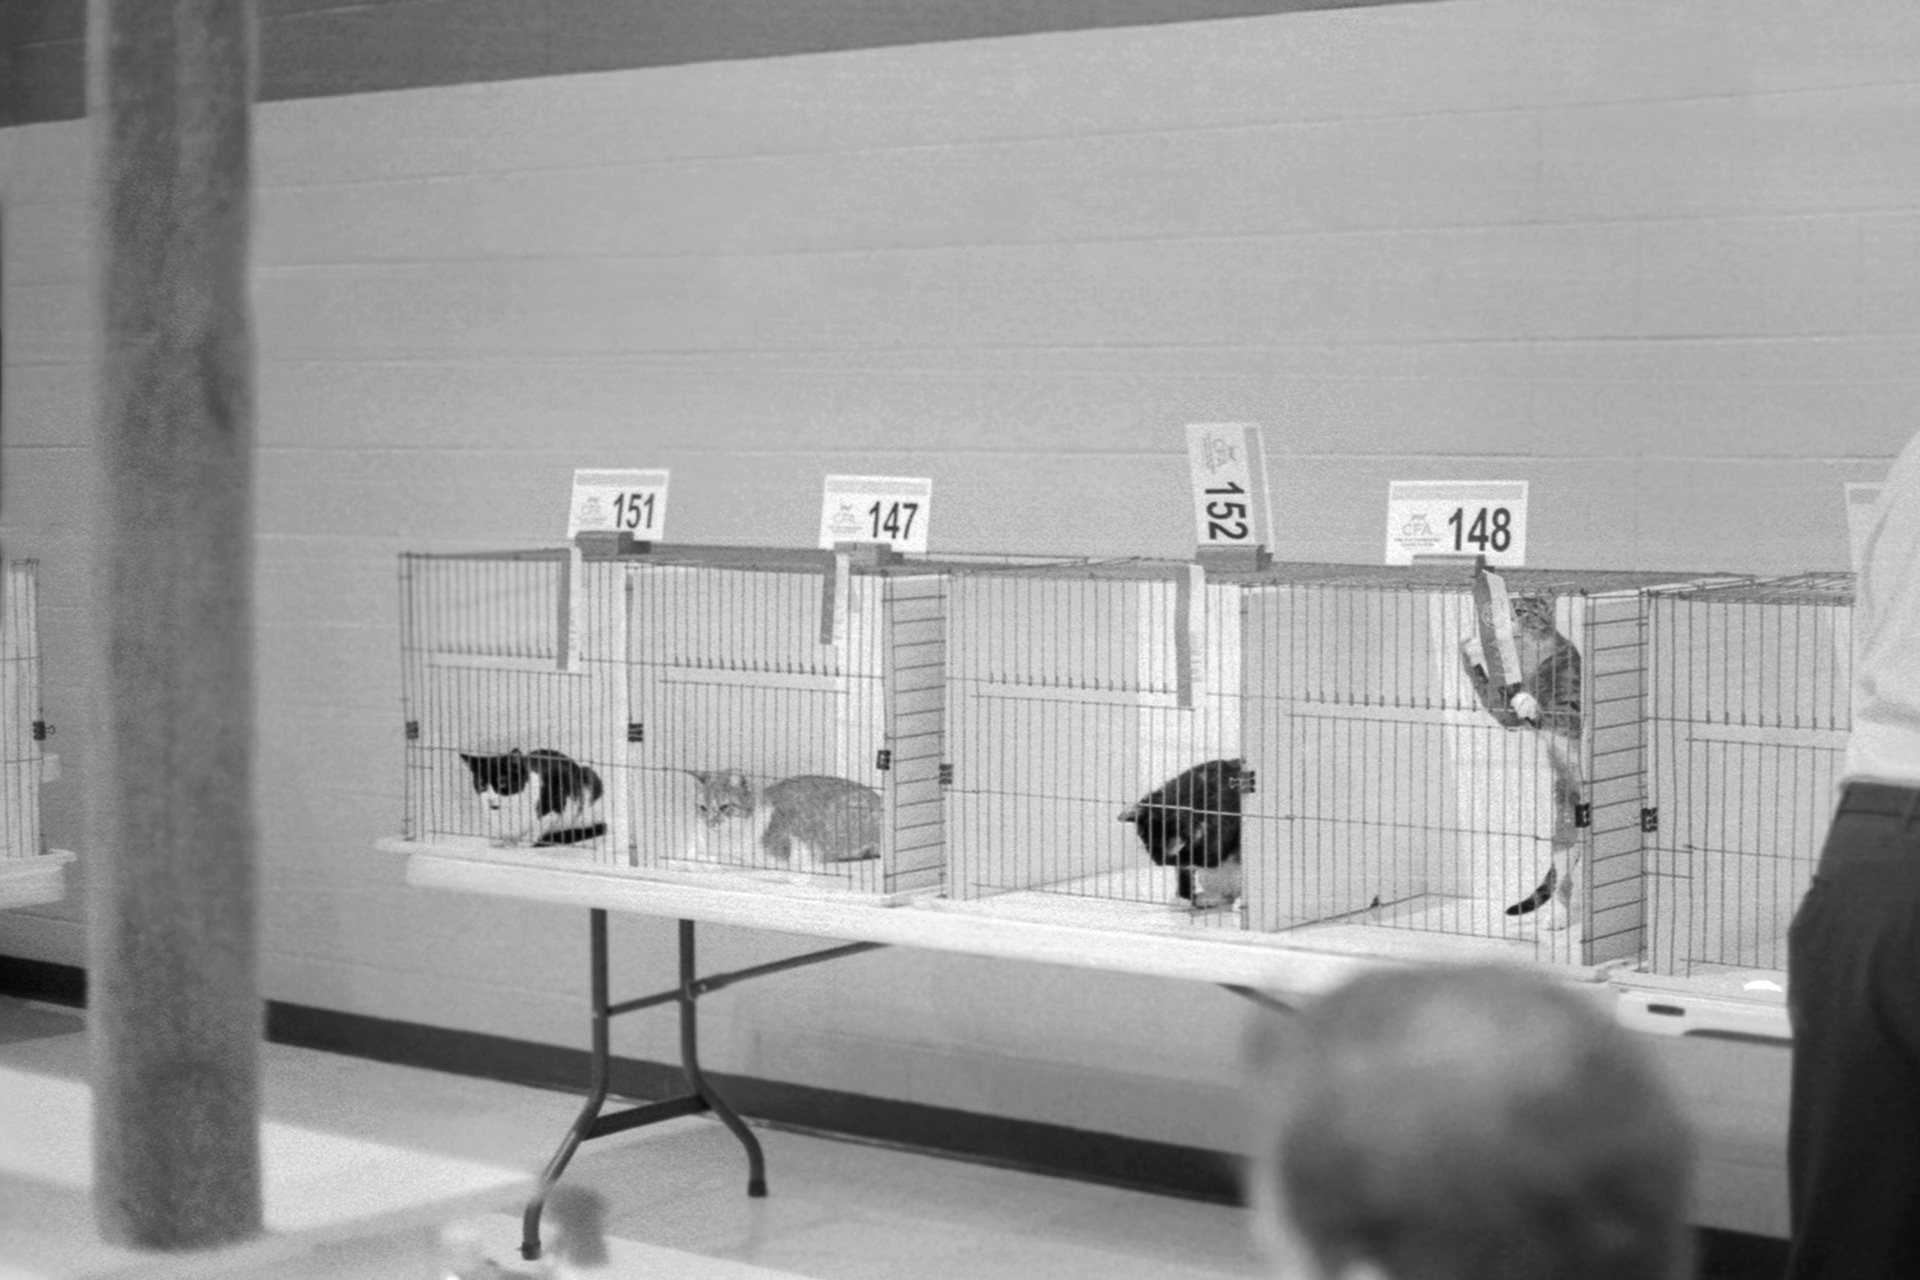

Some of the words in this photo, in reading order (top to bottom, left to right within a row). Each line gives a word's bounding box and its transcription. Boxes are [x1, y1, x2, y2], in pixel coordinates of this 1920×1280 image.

[614, 493, 654, 529] 151
[869, 501, 918, 539] 147
[1205, 481, 1248, 540] 152
[1402, 522, 1433, 536] CFA
[1449, 507, 1511, 552] 148
